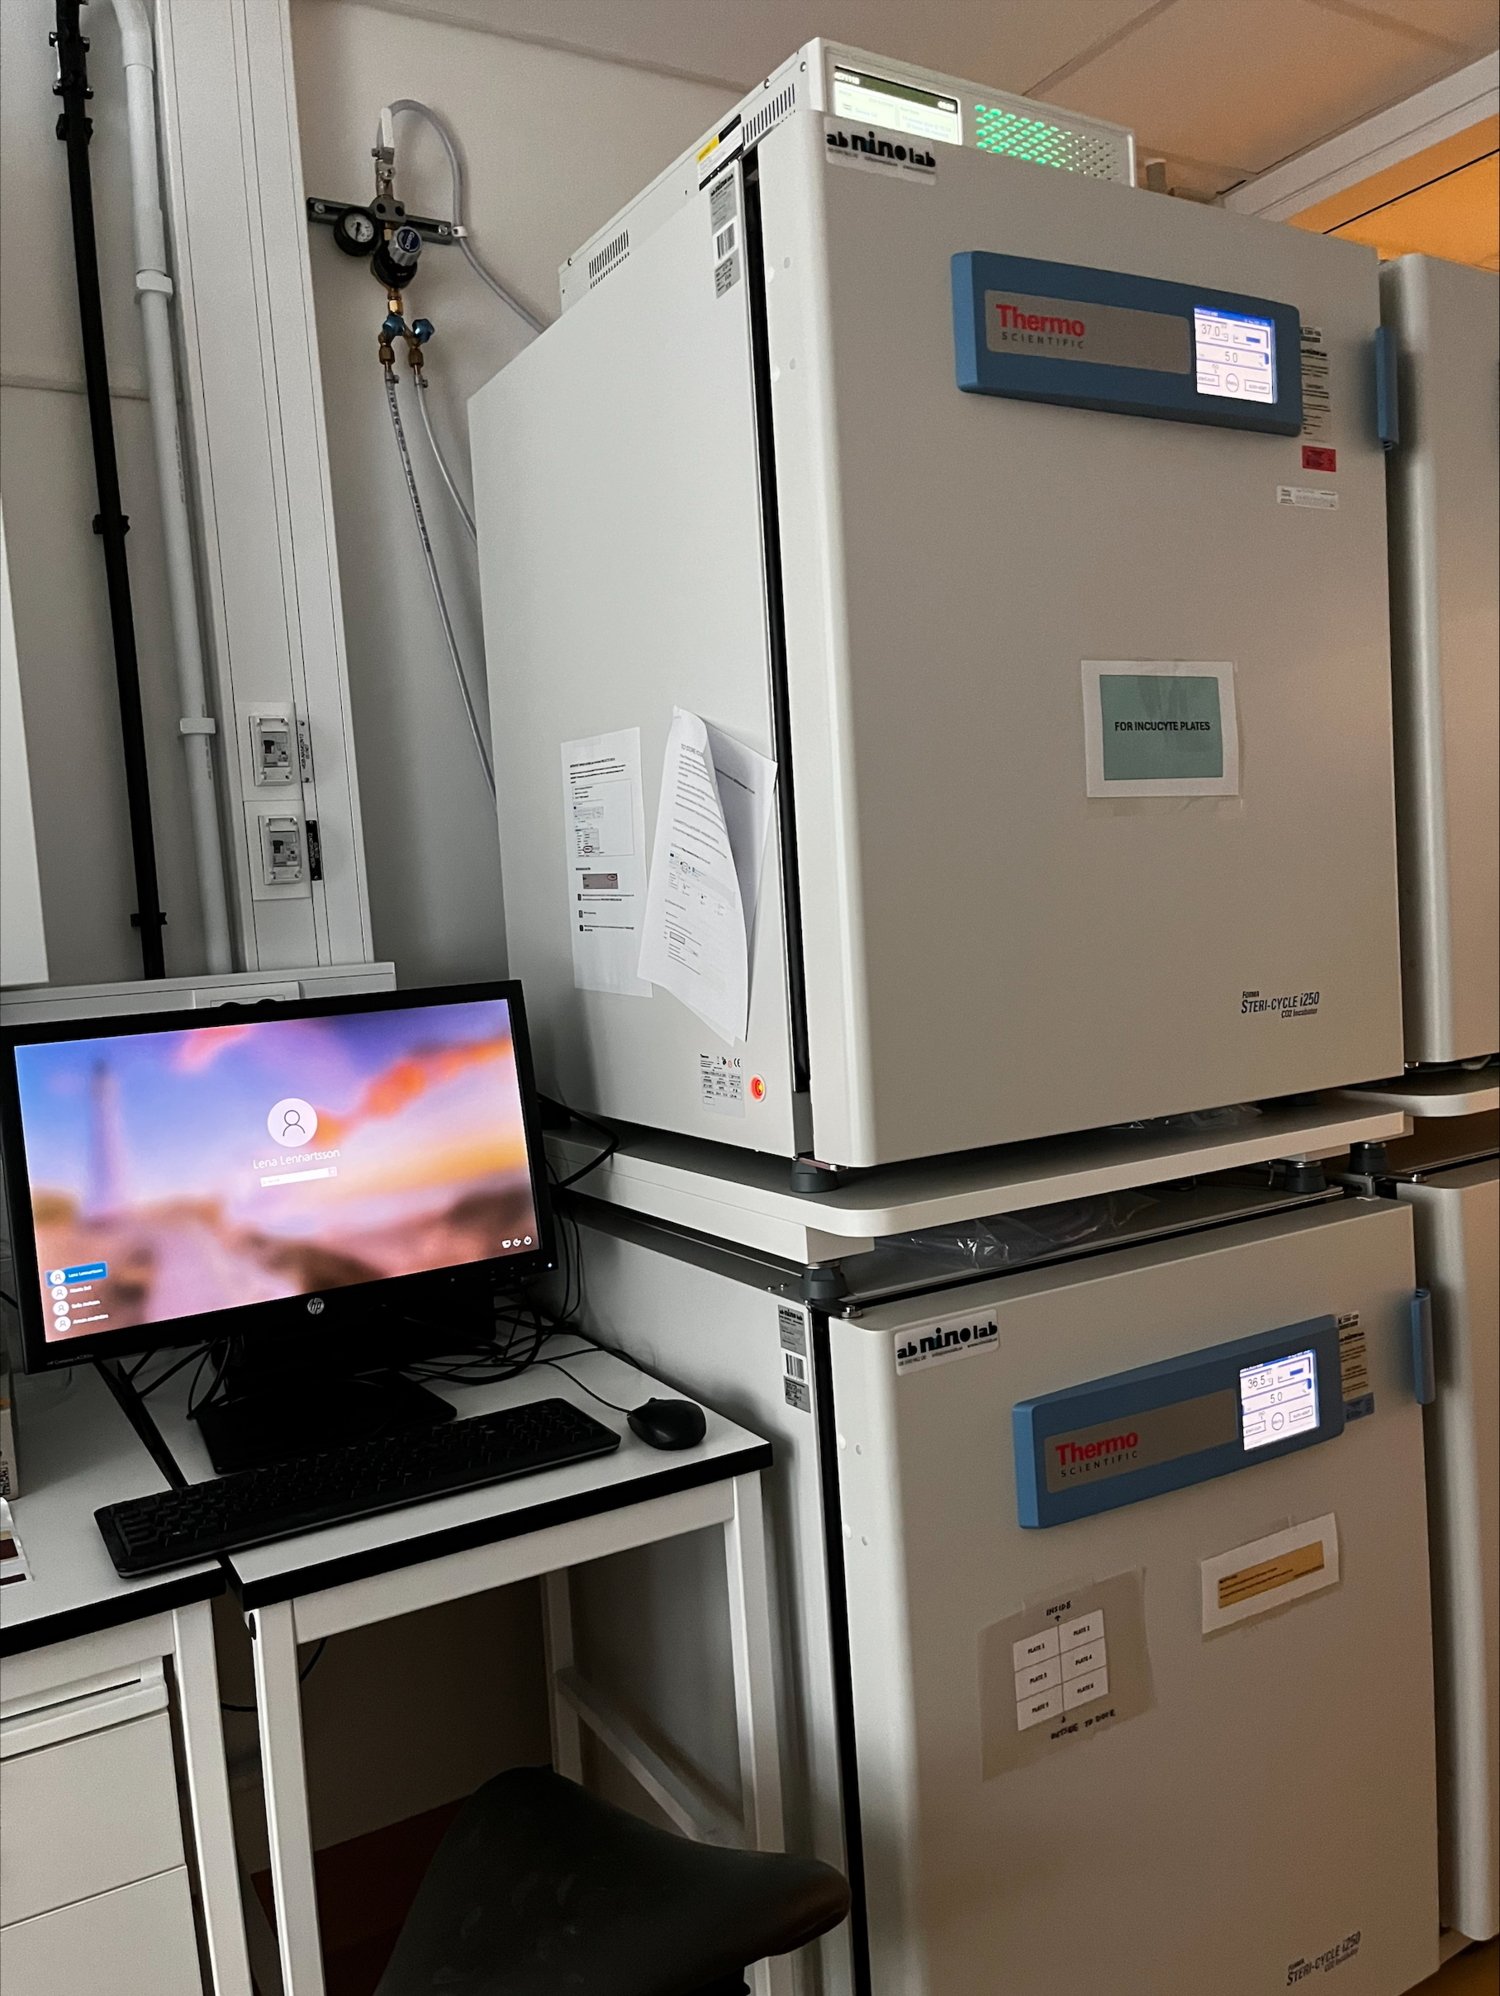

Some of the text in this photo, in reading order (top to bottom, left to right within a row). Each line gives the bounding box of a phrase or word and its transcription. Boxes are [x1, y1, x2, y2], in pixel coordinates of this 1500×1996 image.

[826, 131, 848, 148] ab
[851, 131, 907, 160] nino
[909, 148, 936, 168] lab
[996, 304, 1085, 337] Thermo
[1002, 332, 1084, 349] SCIENTIFIC
[1114, 721, 1210, 732] FOR INCUCYTE PLATES
[1241, 991, 1319, 1014] STERI-CYCLE i250
[253, 1149, 340, 1169] Lena Lennartsson
[897, 1342, 917, 1359] ab
[920, 1327, 971, 1353] nino
[973, 1321, 997, 1339] lab
[1056, 1432, 1138, 1466] Thermo
[1061, 1450, 1138, 1477] SCIENTIFIC
[1073, 1627, 1086, 1636] PLATE
[1028, 1645, 1041, 1654] PLATE
[1075, 1656, 1088, 1665] PLATE
[1030, 1674, 1043, 1684] PLATE
[1077, 1684, 1090, 1693] PLATE
[1032, 1703, 1045, 1713] PLATE
